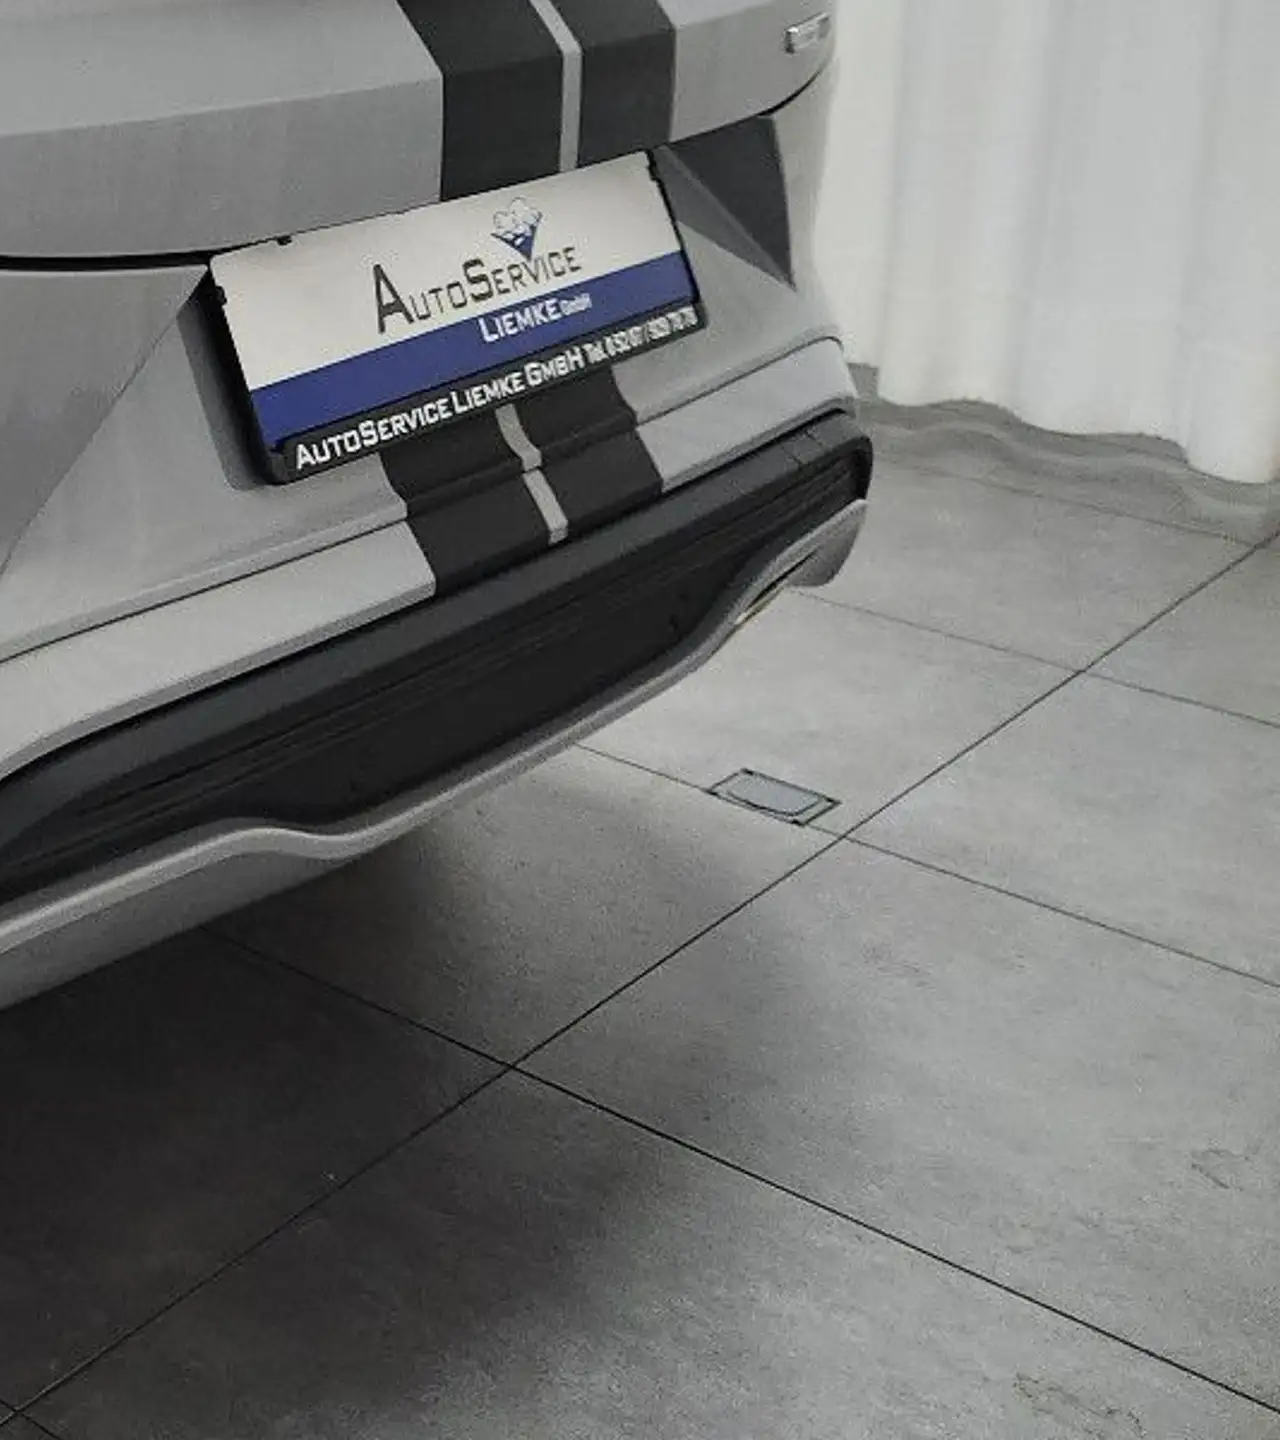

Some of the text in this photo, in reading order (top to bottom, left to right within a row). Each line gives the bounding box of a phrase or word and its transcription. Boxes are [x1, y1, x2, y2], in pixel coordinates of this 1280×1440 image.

[477, 297, 562, 342] LIEMKE
[296, 398, 453, 470] AUTOSERVICE
[451, 371, 526, 414] LIEMKE
